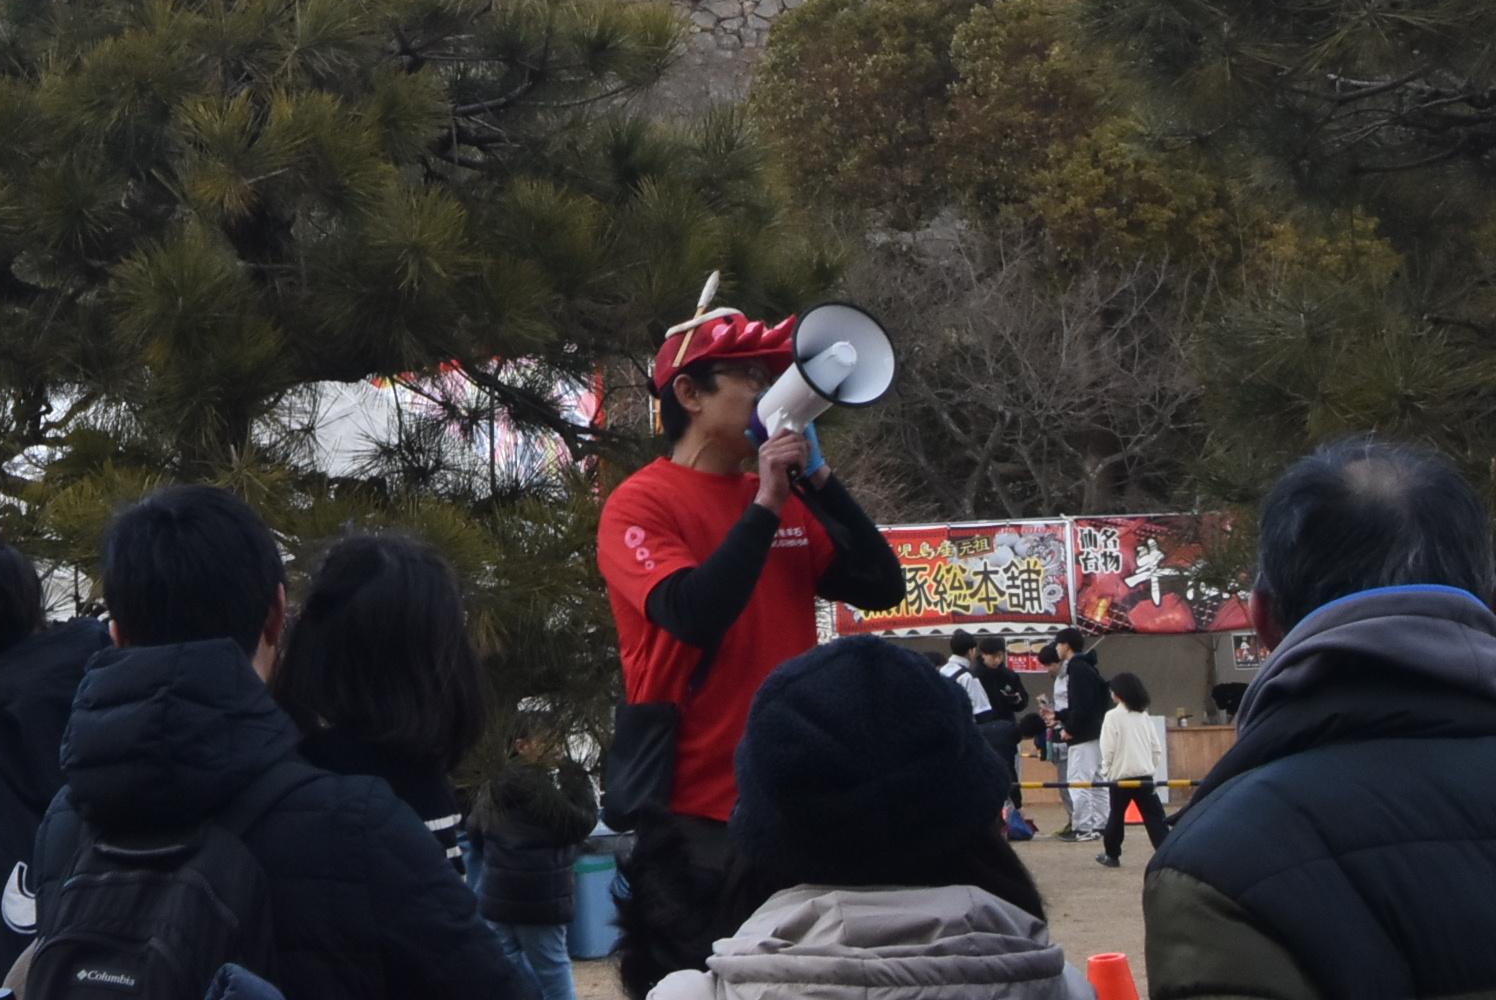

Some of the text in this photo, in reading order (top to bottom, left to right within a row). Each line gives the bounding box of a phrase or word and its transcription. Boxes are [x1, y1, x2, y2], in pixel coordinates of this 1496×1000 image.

[888, 539, 955, 561] 児島産
[959, 537, 991, 556] 元祖
[1078, 528, 1100, 574] 仙台
[1099, 528, 1122, 573] 名物
[862, 556, 1046, 620] 豚総本舗
[87, 970, 136, 987] Columbia
